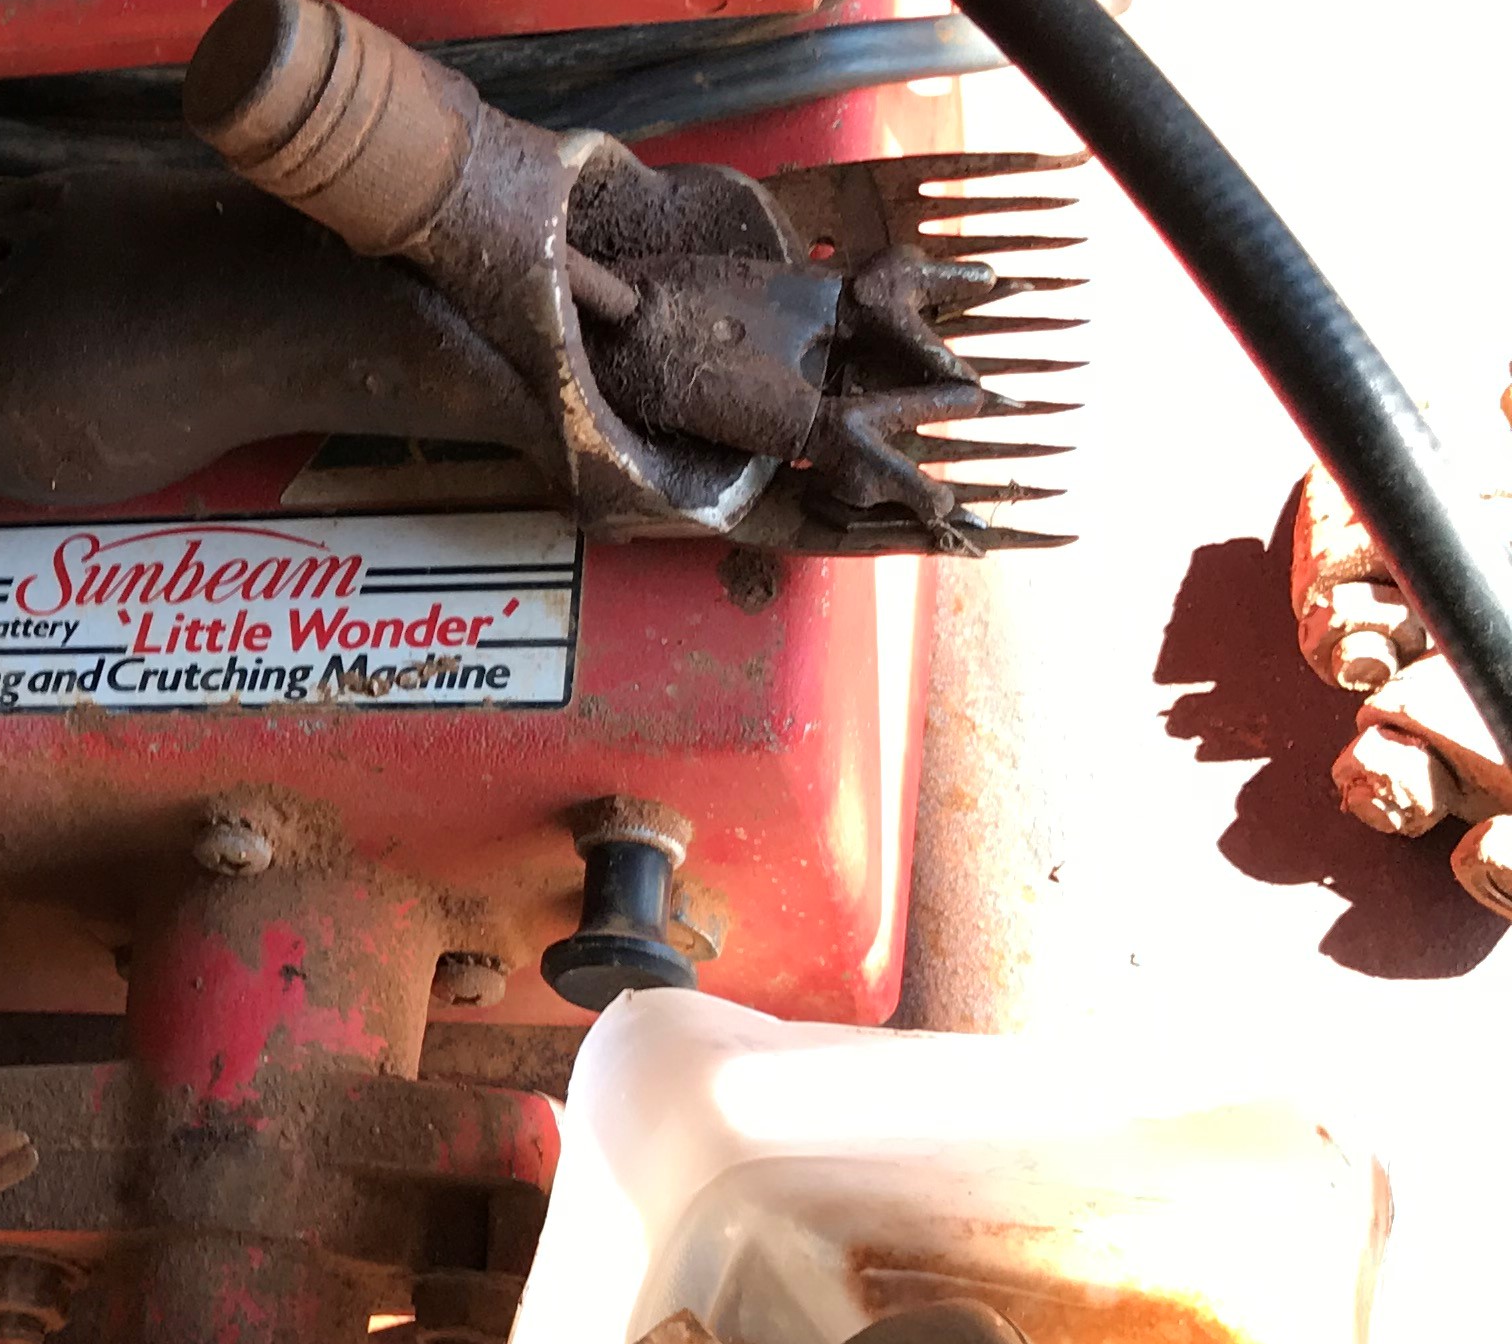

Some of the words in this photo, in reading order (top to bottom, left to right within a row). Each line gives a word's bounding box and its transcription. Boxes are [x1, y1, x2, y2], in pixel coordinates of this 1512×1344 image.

[15, 527, 362, 616] Sunbeam
[27, 657, 106, 694] and
[106, 654, 314, 700] Crutching
[316, 652, 511, 696] Machine
